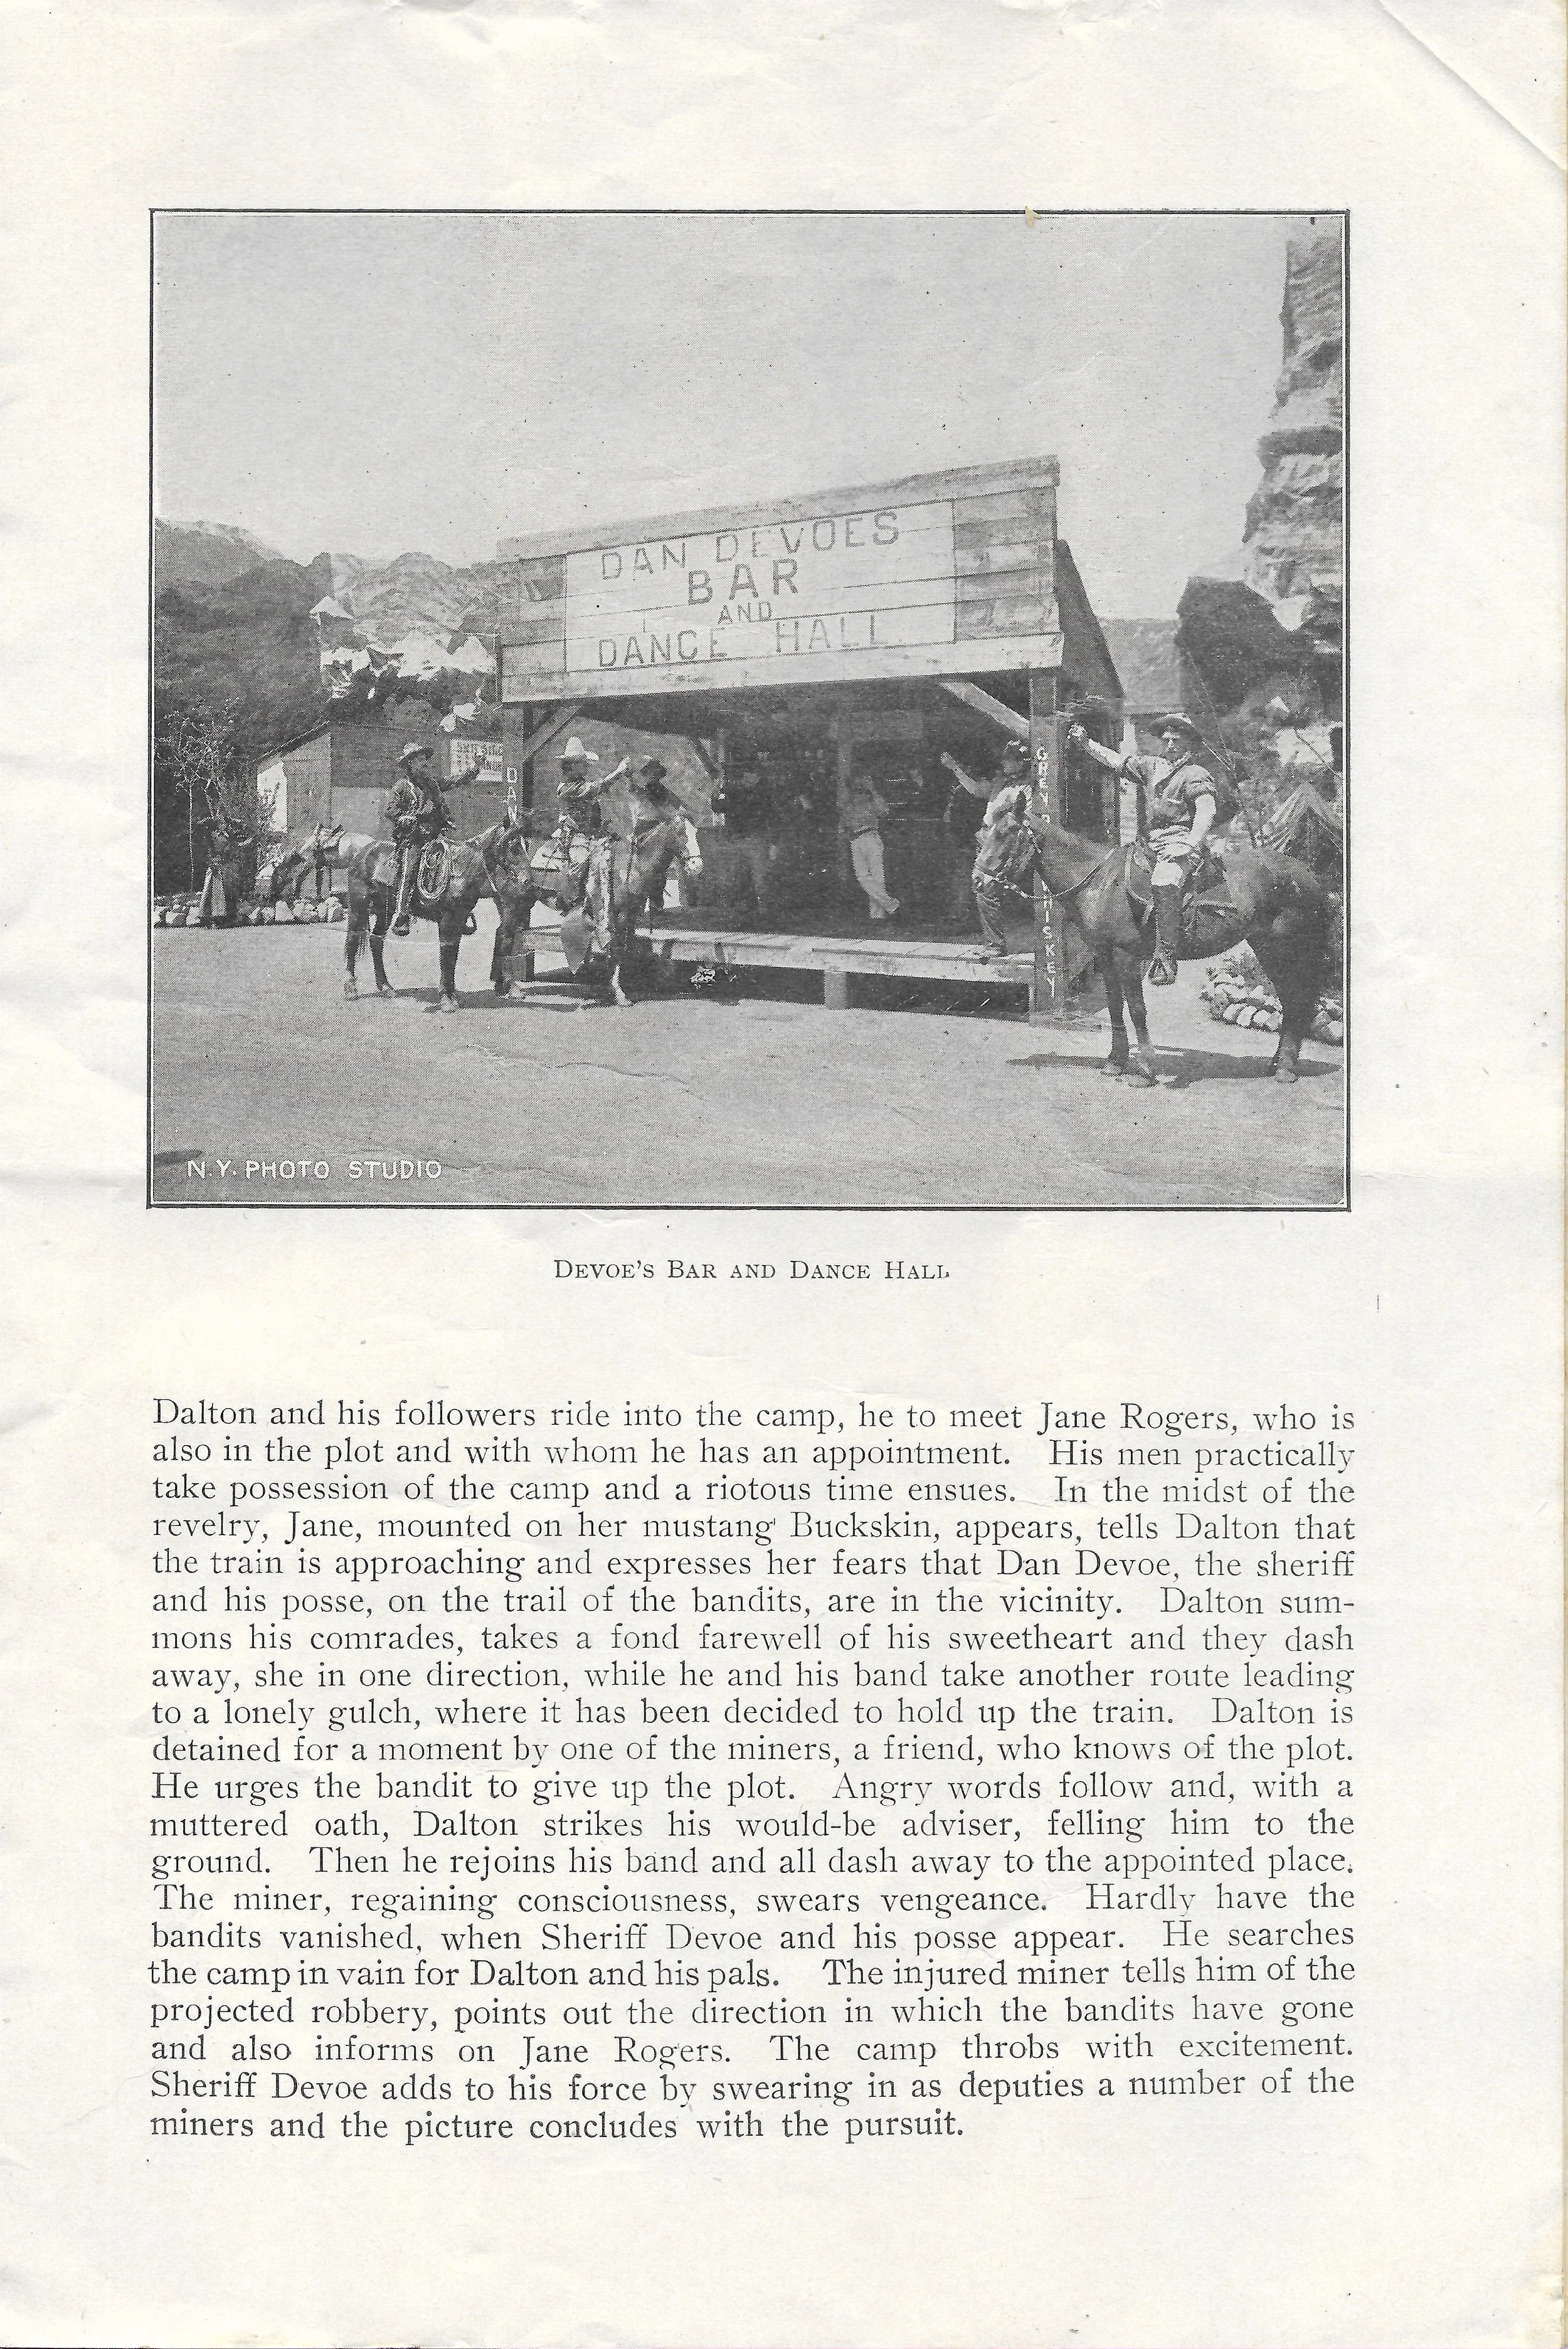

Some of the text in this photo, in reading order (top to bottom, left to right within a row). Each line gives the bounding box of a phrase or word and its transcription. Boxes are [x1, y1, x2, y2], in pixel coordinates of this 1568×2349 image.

[601, 511, 899, 581] DAN DEVOES
[689, 558, 798, 605] BAR
[718, 600, 772, 625] AND
[599, 614, 888, 667] DANCE HALL
[667, 1260, 717, 1278] BAR
[790, 1261, 870, 1279] DANCE
[152, 1397, 1355, 1438] Dalton and his followers ride into the camp, he to meet Jane Rogers, who is
[152, 1473, 1355, 1508] take possession of the camp and a riotous time ensues. In the midst of the
[152, 1547, 1355, 1583] the train is approaching and expresses her fears that Dan Devoe, the sheriff
[151, 1622, 1354, 1658] mons his comrades, takes a fond farewell of his sweetheart and they dash
[152, 1697, 1353, 1732] to a lonely gulch, where it has been decided to hold up the train. Dalton is
[151, 1771, 1353, 1808] He urges the bandit to give up the plot. Angry words follow and, with a
[149, 1808, 1354, 1843] muttered oath, Dalton strikes his would-be adviser, felling him to the
[151, 1919, 1354, 1957] bandits vanished, when Sheriff Devoe and his posse appear. He searches
[150, 1994, 1354, 2034] projected robbery, points out the direction in which the bandits have gone
[150, 2108, 963, 2146] miners and the picture concludes with the pursuit.
